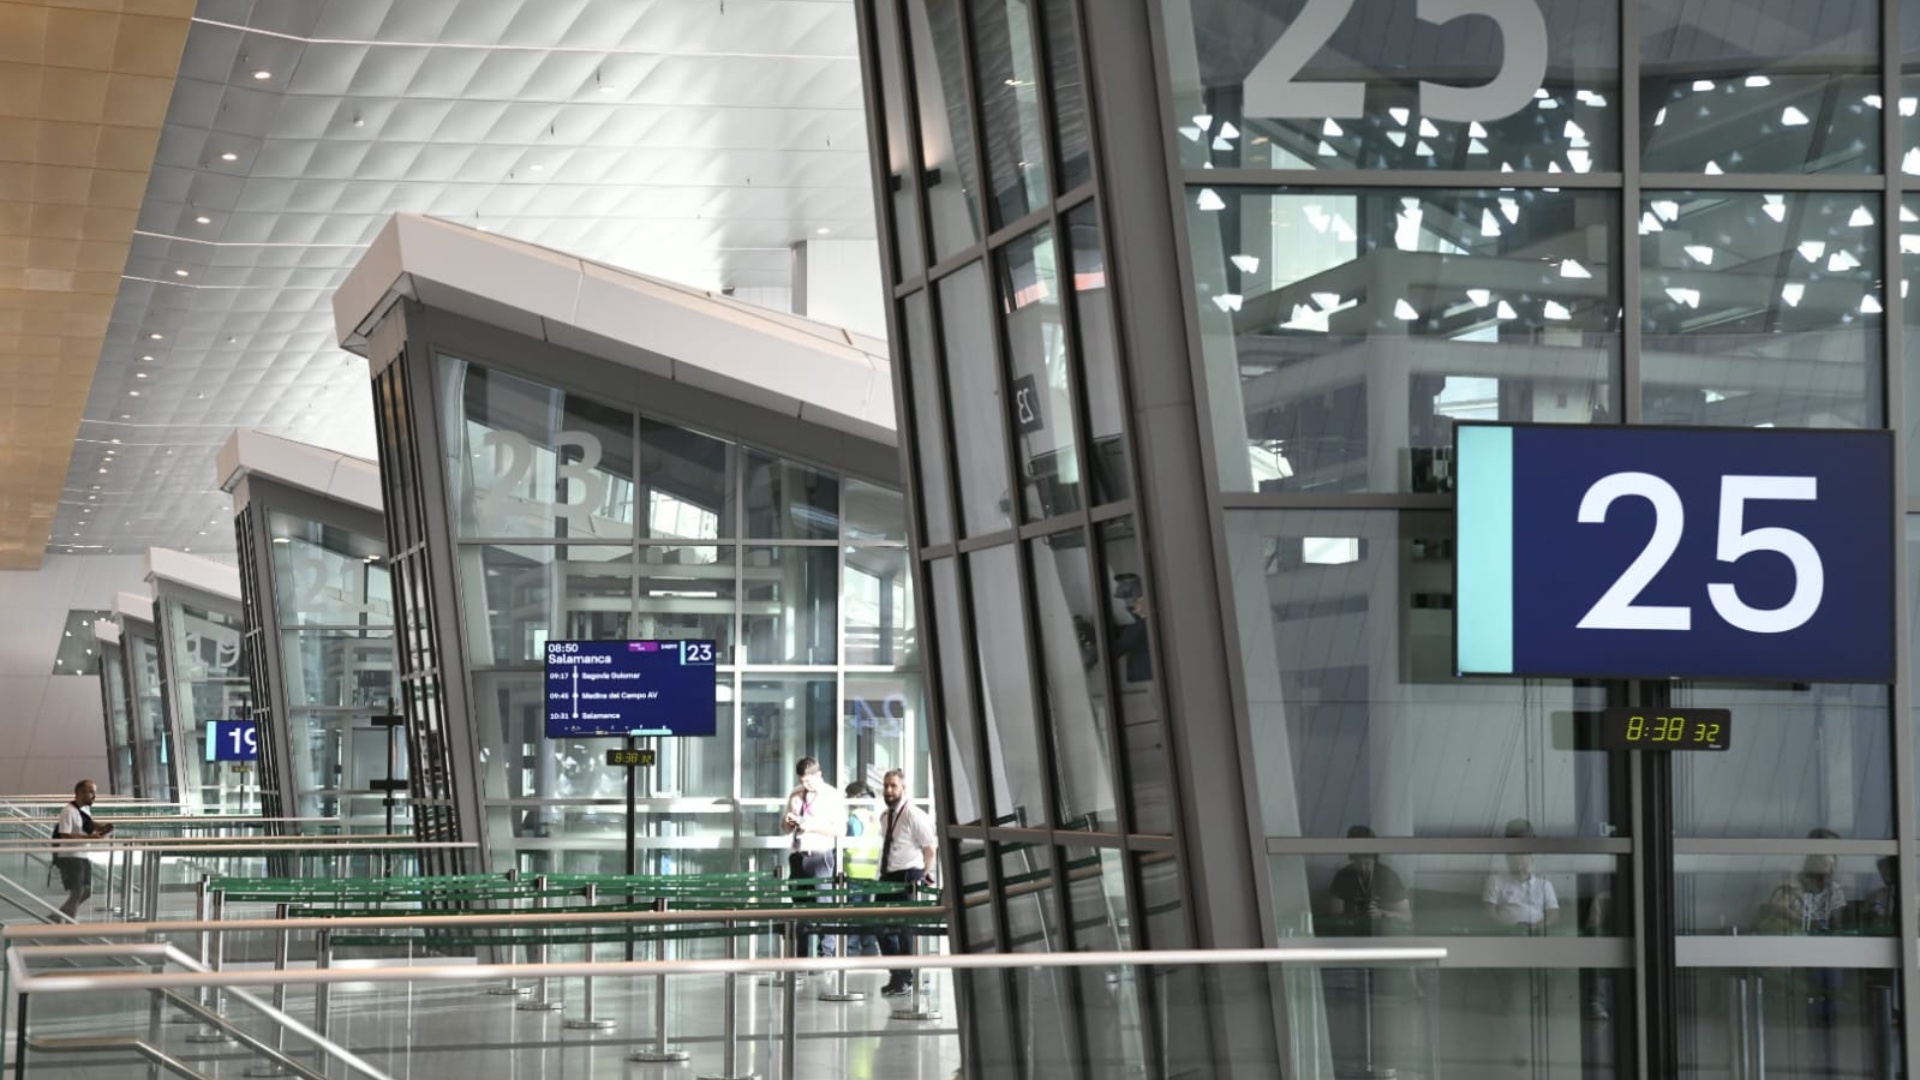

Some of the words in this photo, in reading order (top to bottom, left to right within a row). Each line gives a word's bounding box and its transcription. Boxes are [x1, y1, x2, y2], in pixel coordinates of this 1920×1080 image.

[1242, 0, 1549, 123] 25
[475, 429, 603, 519] 23
[1575, 471, 1824, 634] 25
[548, 643, 579, 653] 08:50
[687, 644, 712, 661] 23
[548, 653, 612, 665] Salamanca
[582, 692, 607, 700] Medina
[609, 691, 620, 700] del
[621, 691, 647, 701] Campo
[647, 691, 659, 699] AV
[582, 711, 621, 720] Salamanca
[1626, 716, 1685, 742] 8:38
[1693, 723, 1721, 742] 32
[228, 727, 257, 755] 19
